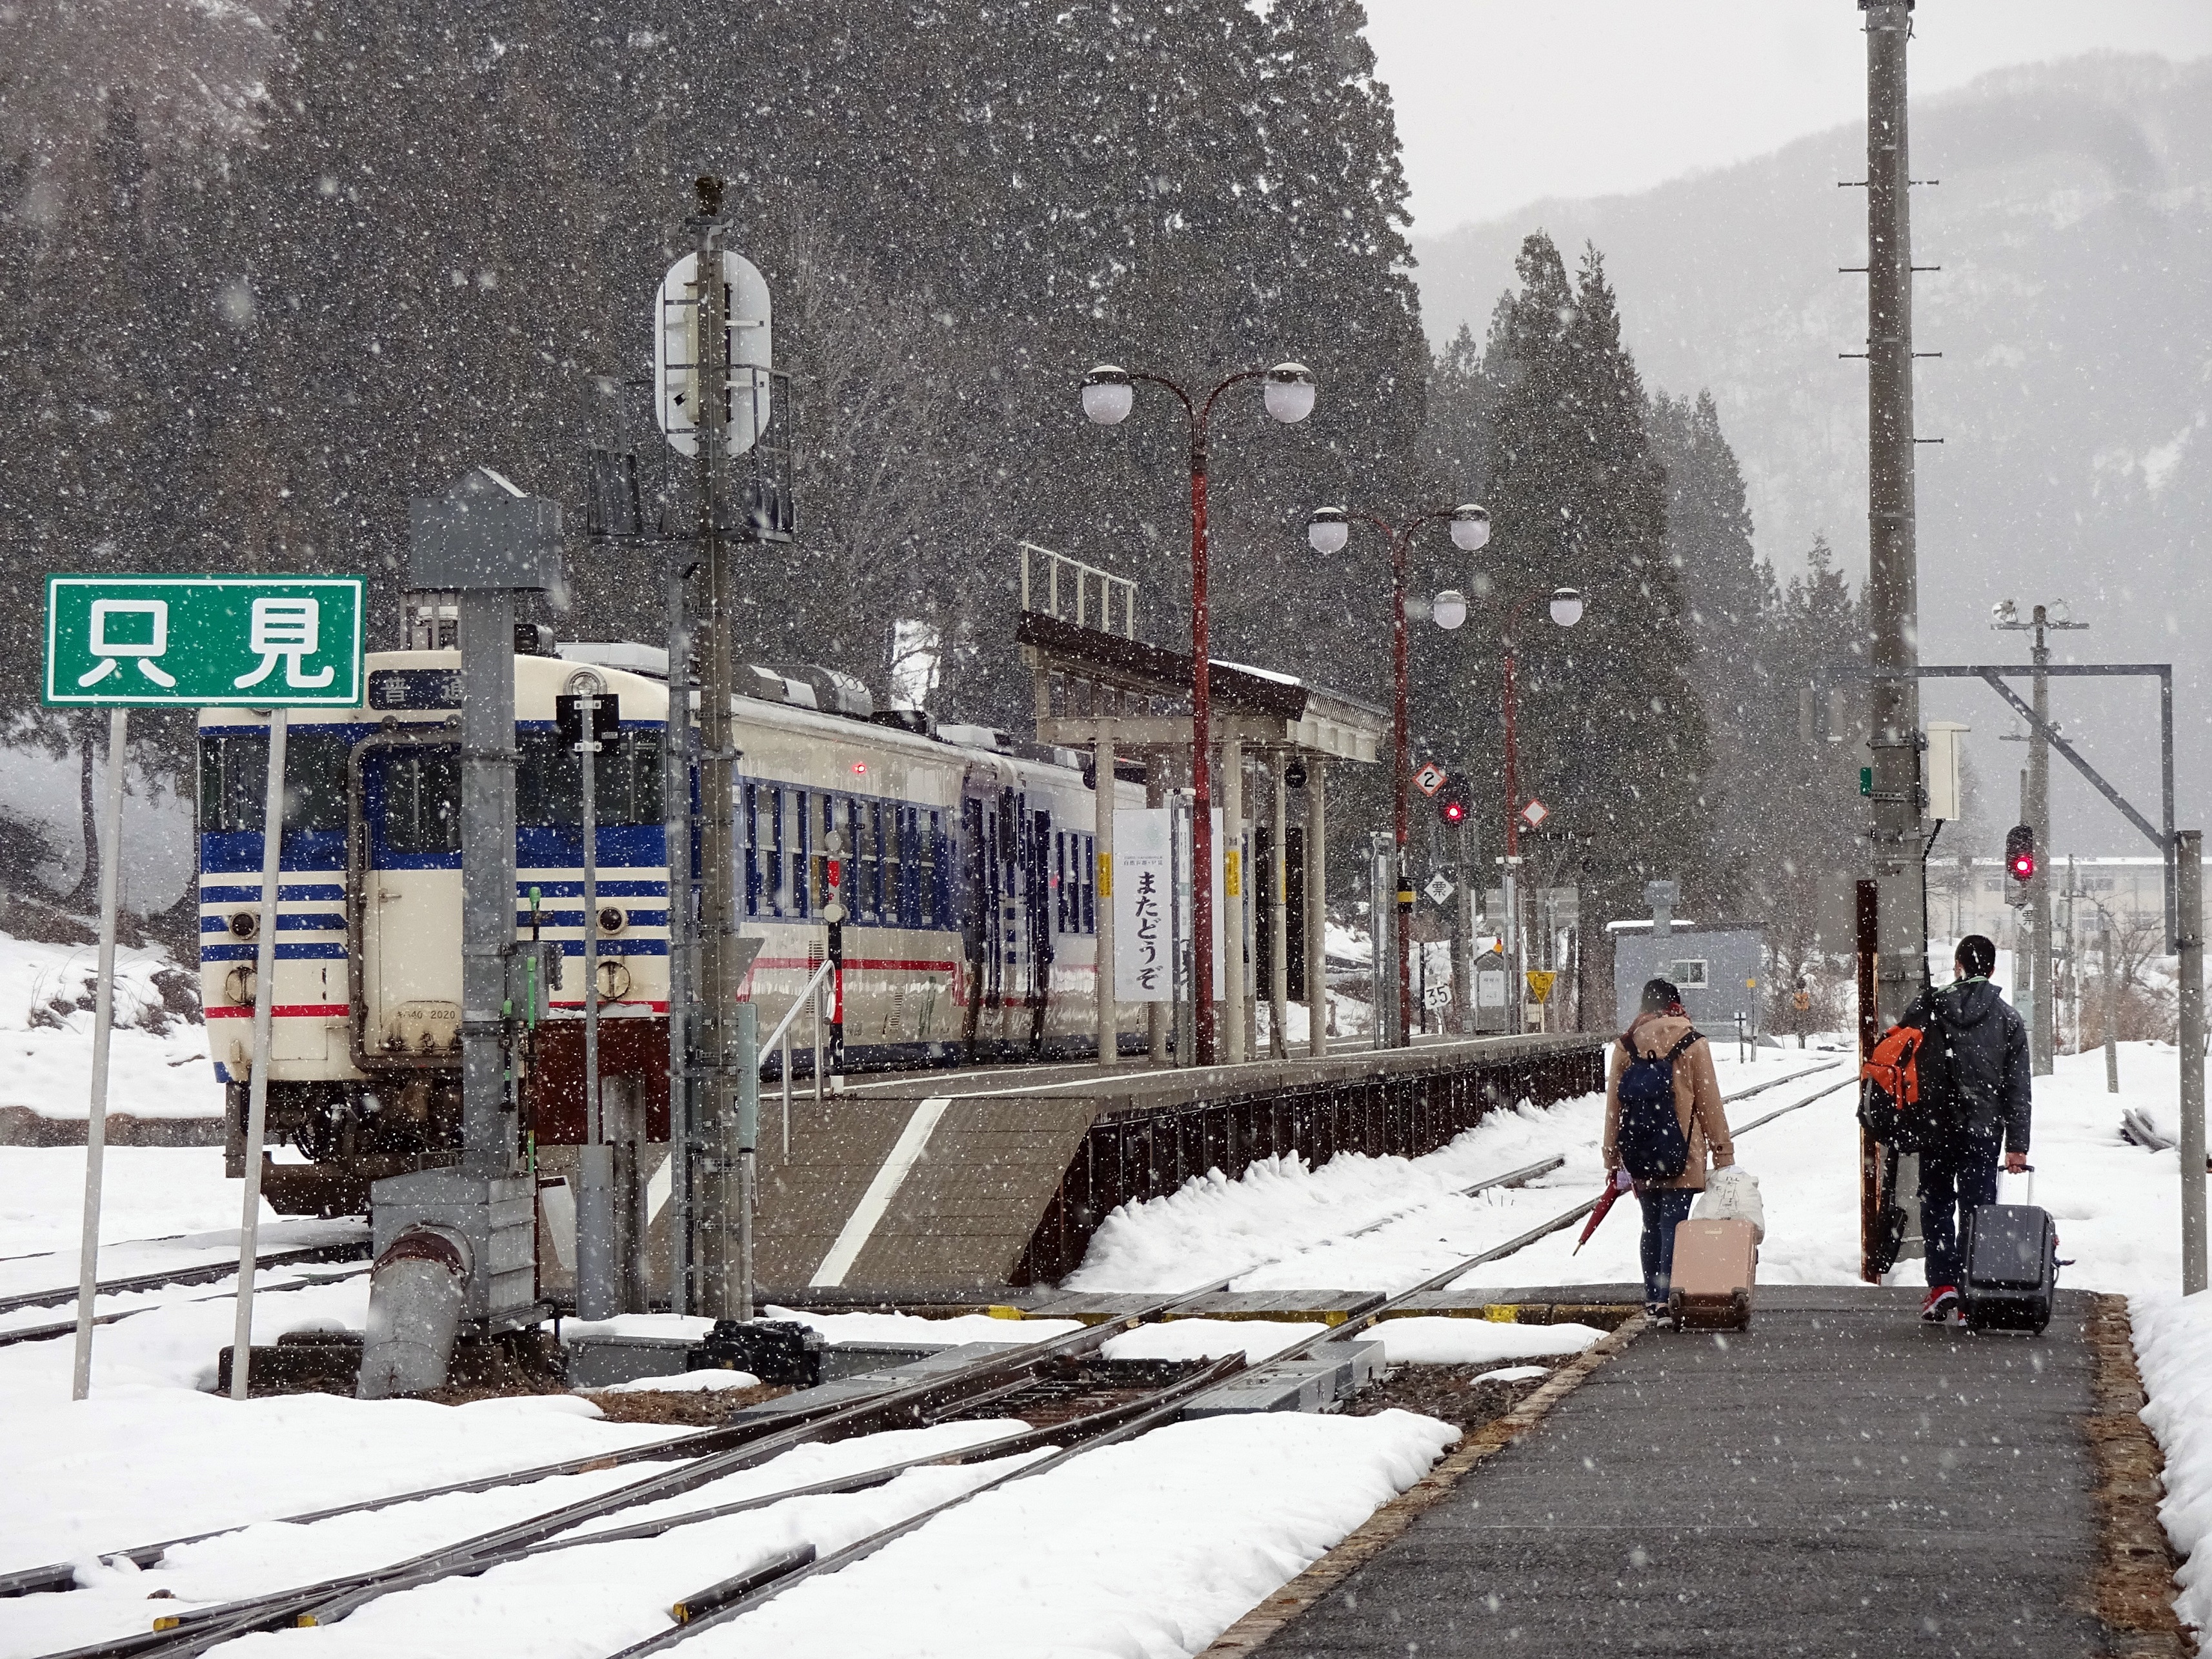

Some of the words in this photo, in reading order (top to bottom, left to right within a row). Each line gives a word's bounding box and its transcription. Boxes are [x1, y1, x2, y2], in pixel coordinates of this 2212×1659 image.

[78, 598, 334, 689] 只見
[1424, 772, 1435, 787] 2
[1432, 881, 1446, 896] 票
[1136, 872, 1163, 990] またどうぞ
[1425, 985, 1448, 1005] 35
[430, 1010, 456, 1019] 2020
